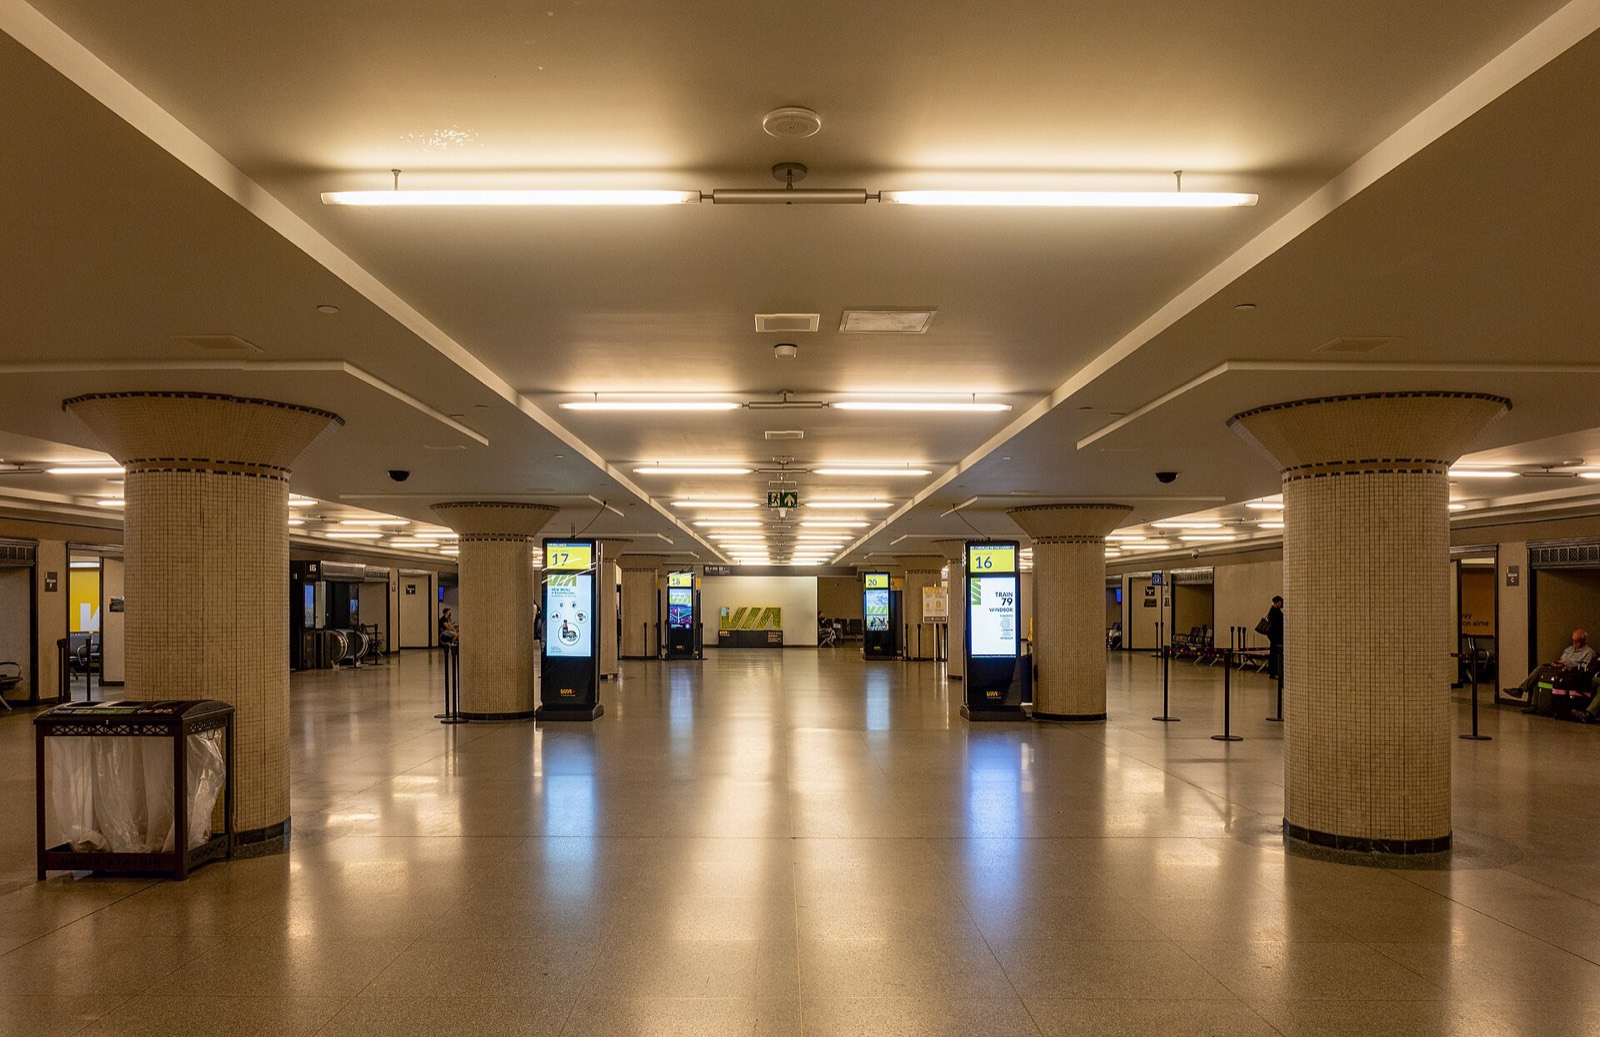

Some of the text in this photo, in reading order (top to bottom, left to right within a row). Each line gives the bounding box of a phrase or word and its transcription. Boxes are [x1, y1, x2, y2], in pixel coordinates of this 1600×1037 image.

[552, 553, 569, 567] 17
[975, 556, 993, 569] 16
[868, 579, 878, 587] 20
[1001, 597, 1013, 606] 79
